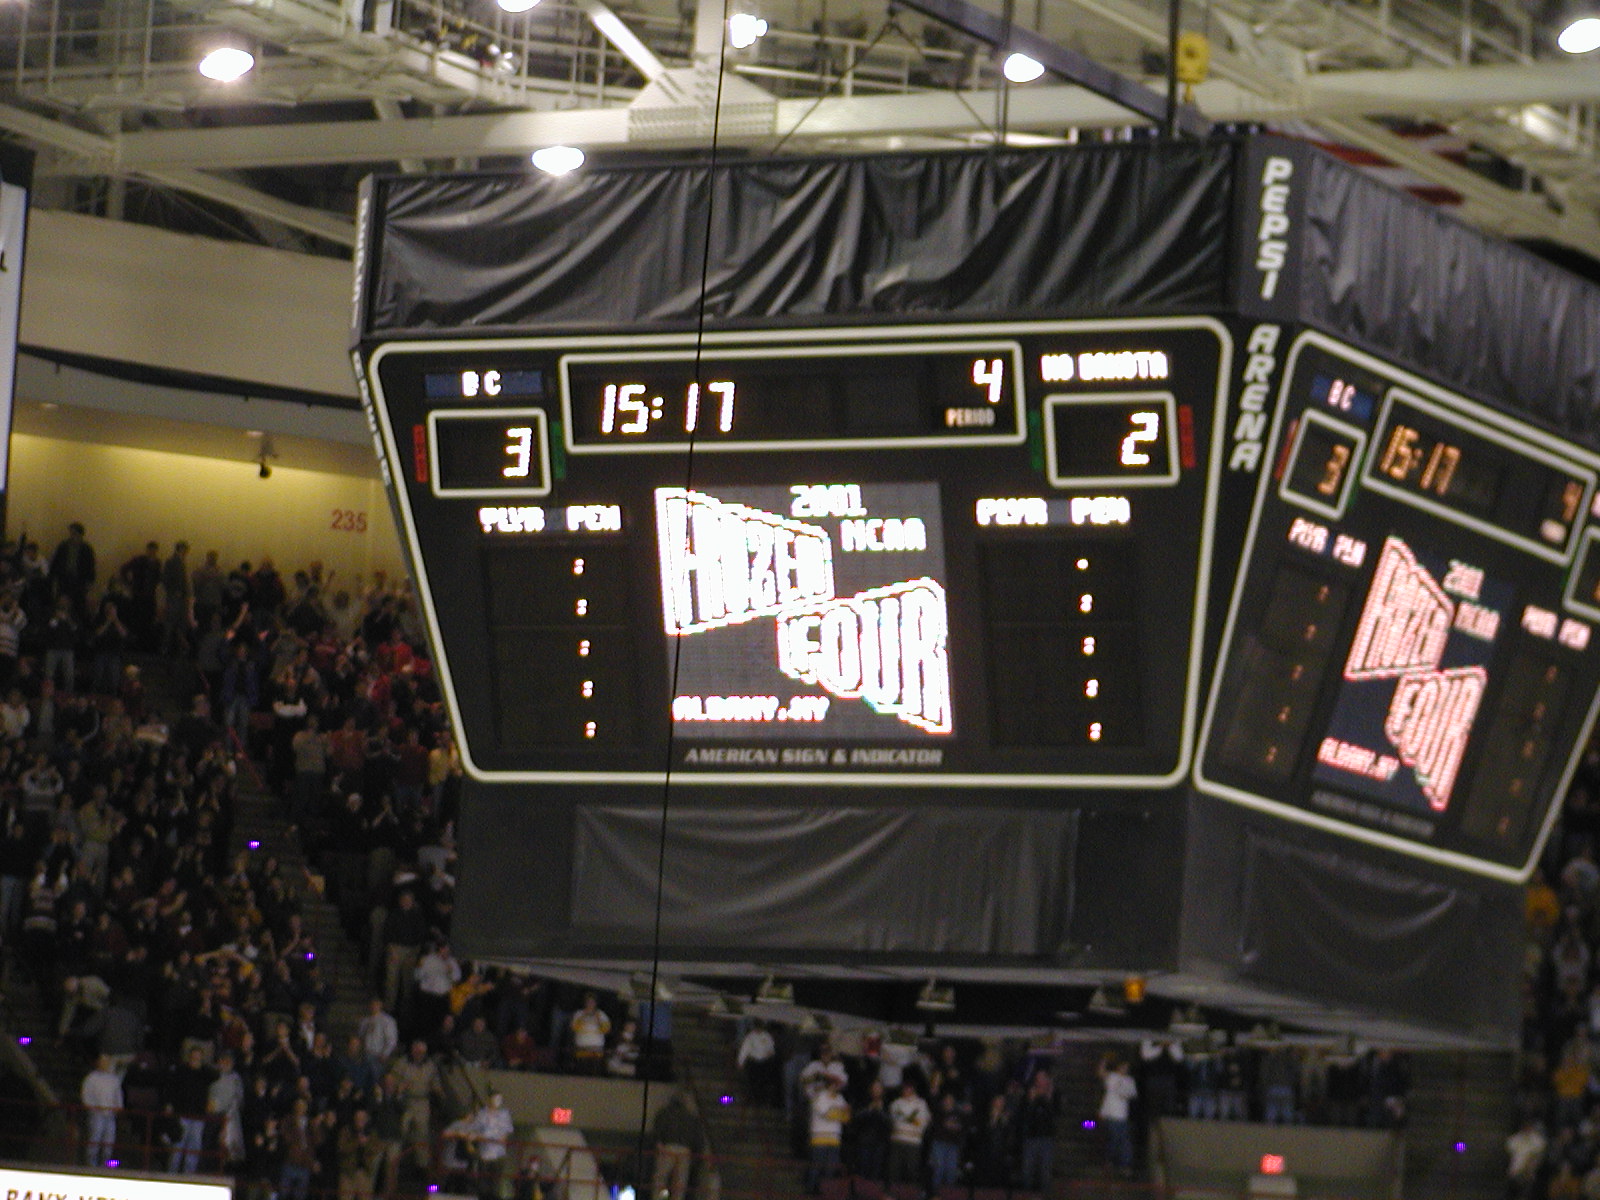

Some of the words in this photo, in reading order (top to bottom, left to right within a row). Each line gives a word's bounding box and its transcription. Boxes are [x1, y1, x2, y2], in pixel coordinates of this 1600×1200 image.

[1256, 156, 1294, 300] PEPSI
[972, 359, 1004, 403] 4
[1229, 323, 1281, 473] ARENA
[601, 381, 736, 434] 15:17
[945, 407, 995, 427] PERIOD
[502, 426, 533, 477] 3
[1120, 411, 1160, 466] 2
[331, 508, 368, 533] 235
[839, 517, 927, 552] NCAA
[684, 747, 780, 764] AMERICAN
[780, 748, 829, 764] SIGN
[851, 748, 944, 765] INDICATOR
